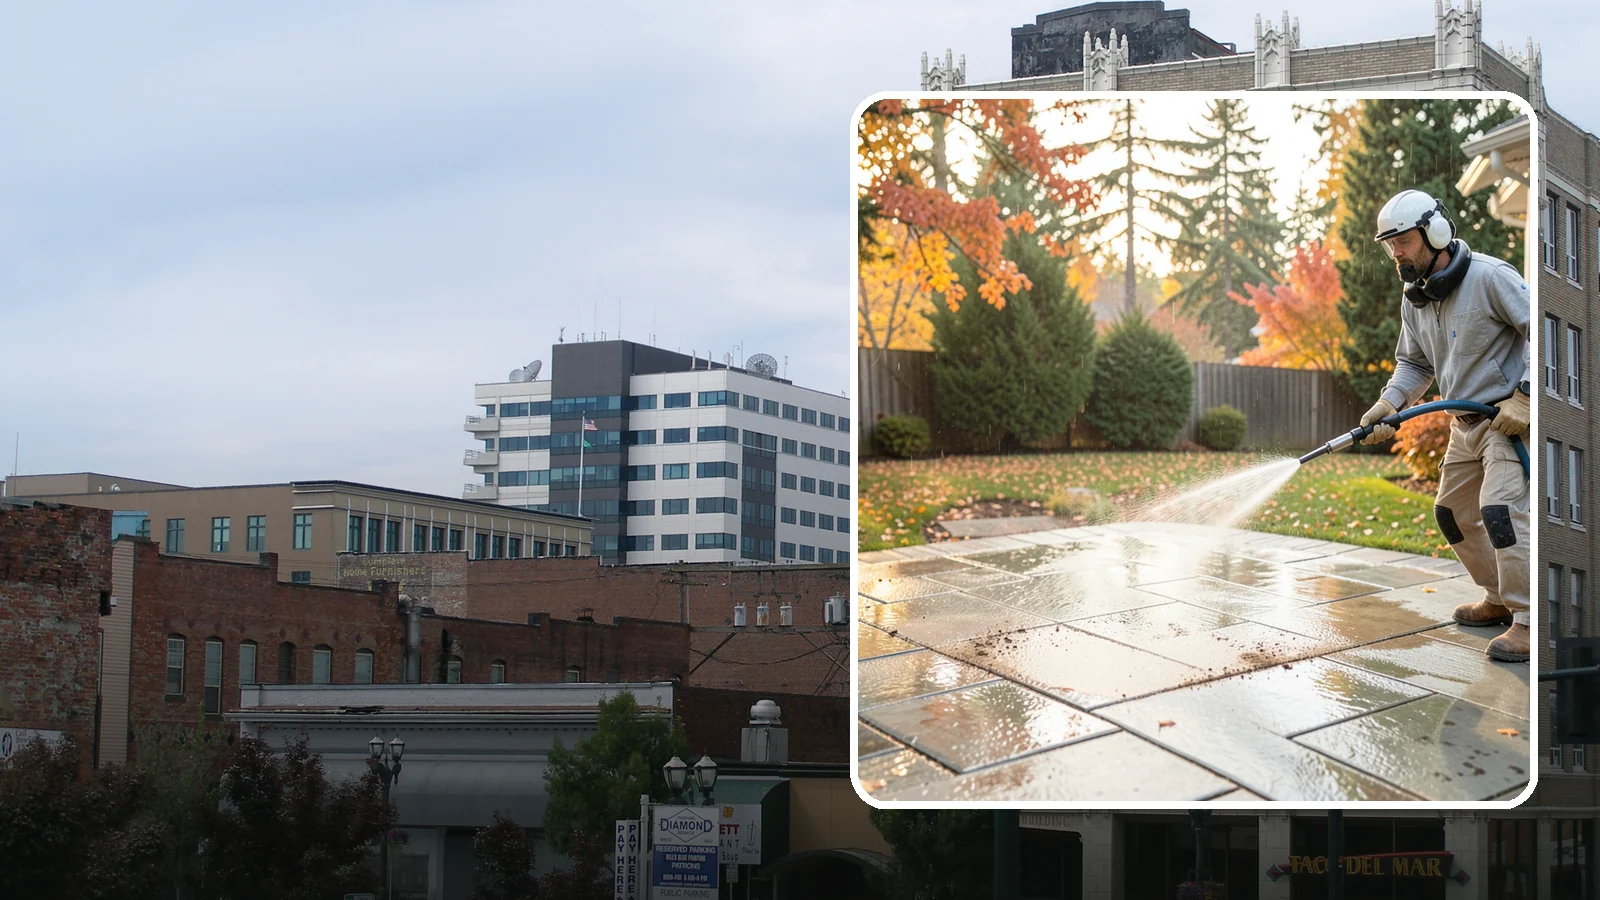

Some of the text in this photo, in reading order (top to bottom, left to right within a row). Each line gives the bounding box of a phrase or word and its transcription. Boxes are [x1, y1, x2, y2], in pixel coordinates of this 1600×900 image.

[343, 566, 427, 577] Home Furnishers
[660, 818, 713, 833] DIAMOND
[1022, 815, 1069, 828] BUILDING
[689, 846, 716, 854] PARKING
[617, 825, 625, 894] PAY HERE
[628, 824, 637, 893] PAY HERE
[721, 851, 739, 862] Soup
[671, 862, 701, 870] PATRONS
[1346, 856, 1385, 876] DEL
[1392, 857, 1442, 877] MAR
[660, 888, 710, 898] PUBLIC PARKING
